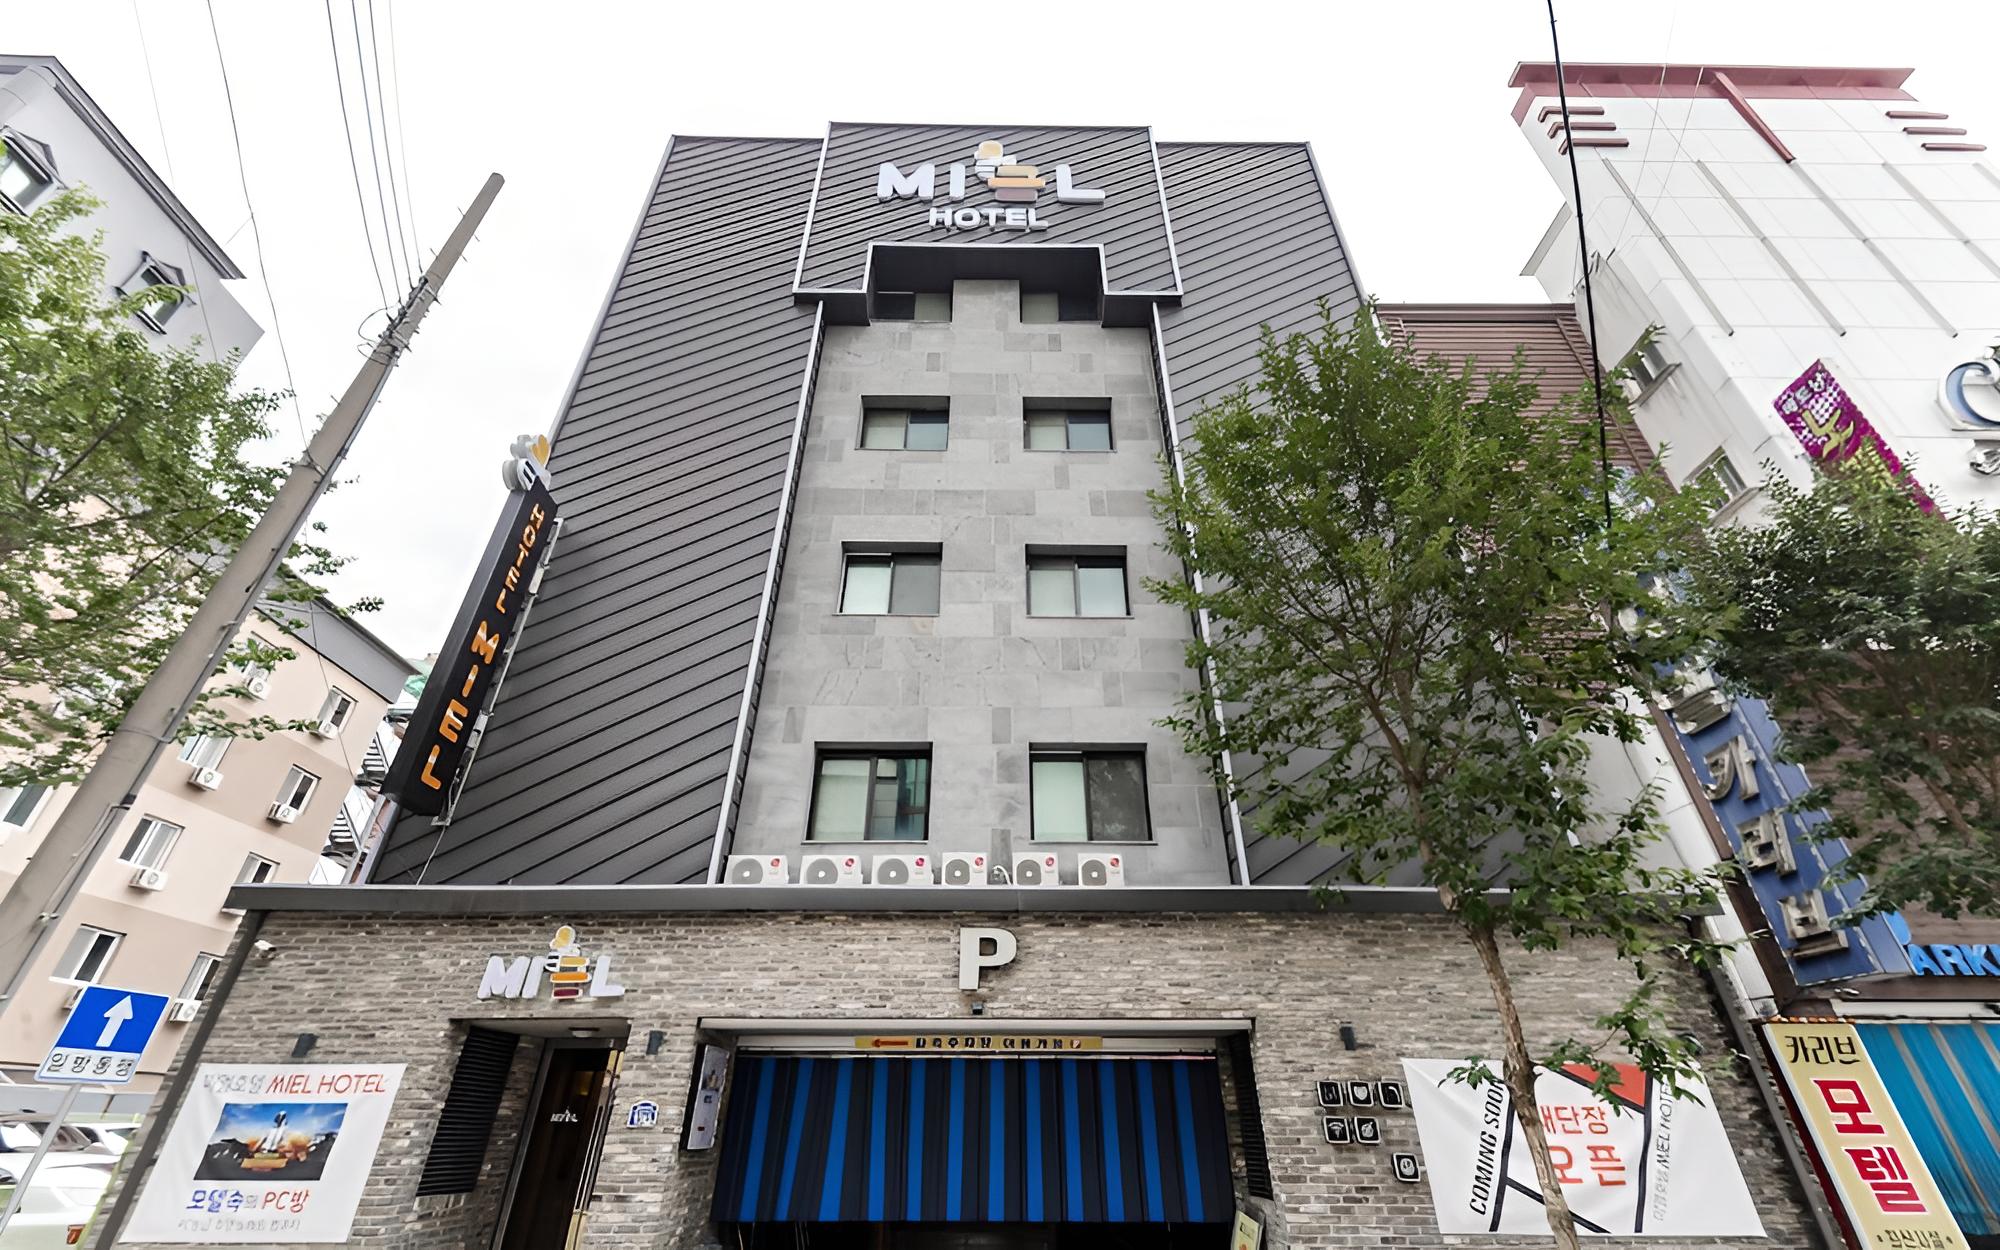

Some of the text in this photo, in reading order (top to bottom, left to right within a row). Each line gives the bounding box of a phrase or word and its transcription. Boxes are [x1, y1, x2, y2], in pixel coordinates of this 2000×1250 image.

[929, 207, 1049, 232] HOTEL
[420, 503, 545, 790] HOTEL MIEL
[959, 927, 1017, 990] P
[1785, 1036, 1861, 1064] 카리브
[266, 1074, 311, 1094] MIEL
[317, 1074, 386, 1094] HOTEL
[1469, 1131, 1498, 1216] COMING
[1811, 1078, 1928, 1213] 모텔
